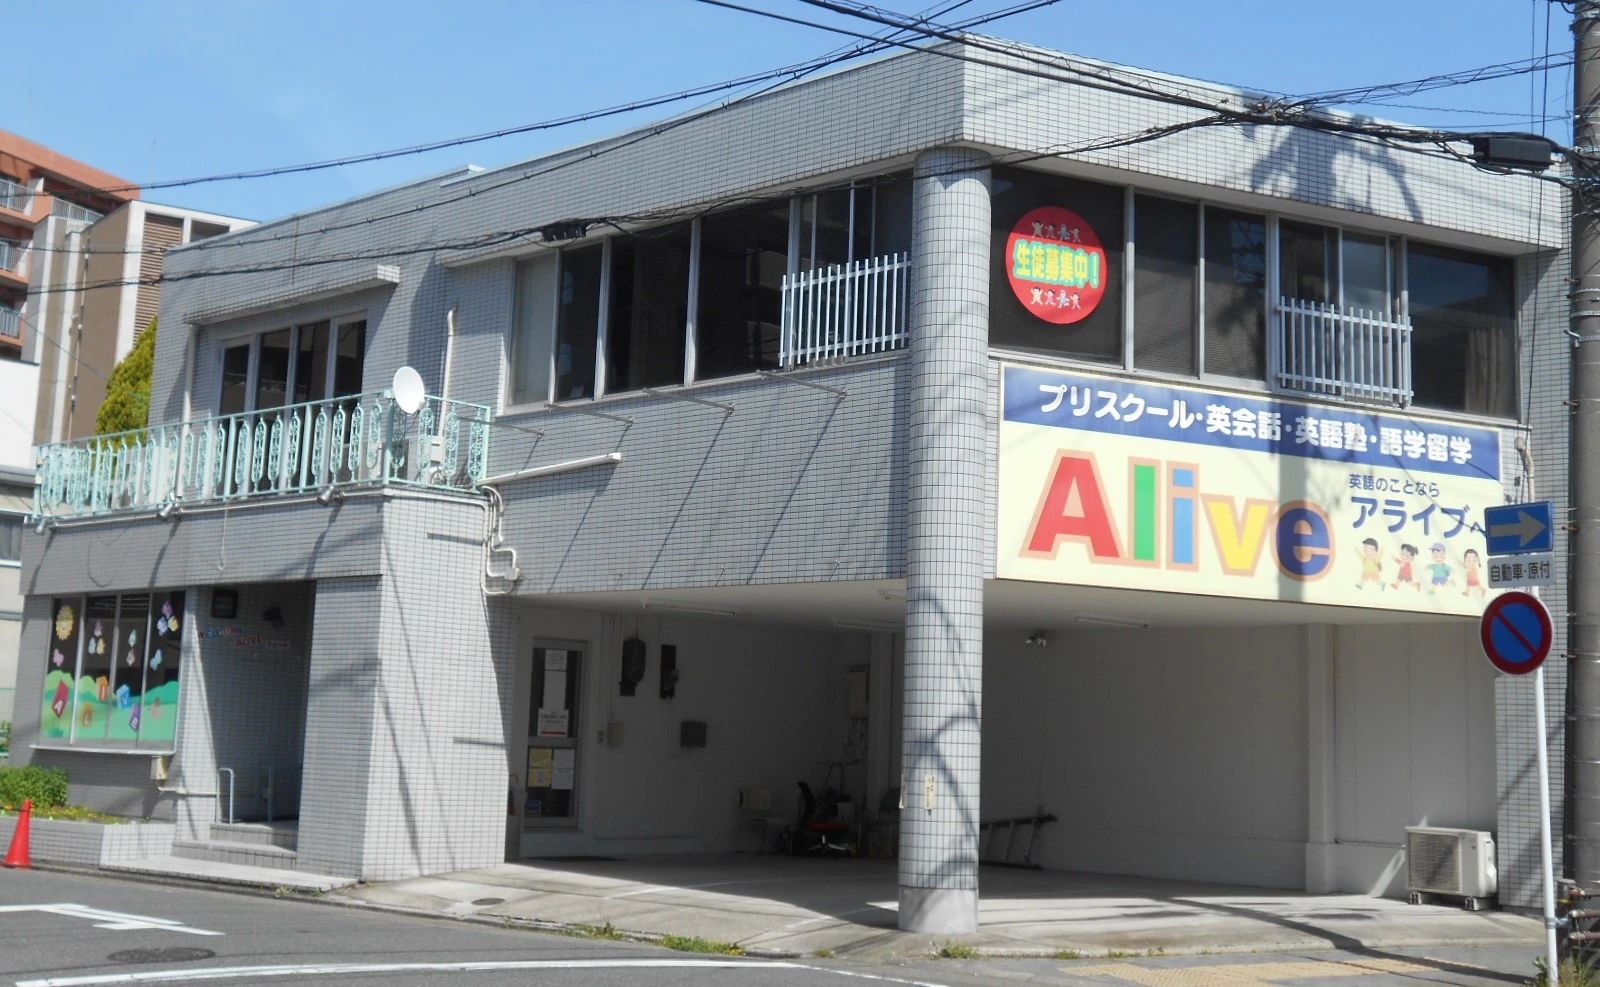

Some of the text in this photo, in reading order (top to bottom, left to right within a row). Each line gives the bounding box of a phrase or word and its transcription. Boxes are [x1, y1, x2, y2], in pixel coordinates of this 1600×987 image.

[1039, 383, 1473, 465] プリスクール・英会話・英語塾・語学留学
[1349, 473, 1440, 497] 英語のことなら
[1019, 448, 1336, 581] Alive
[1491, 561, 1551, 582] 自動車・原付
